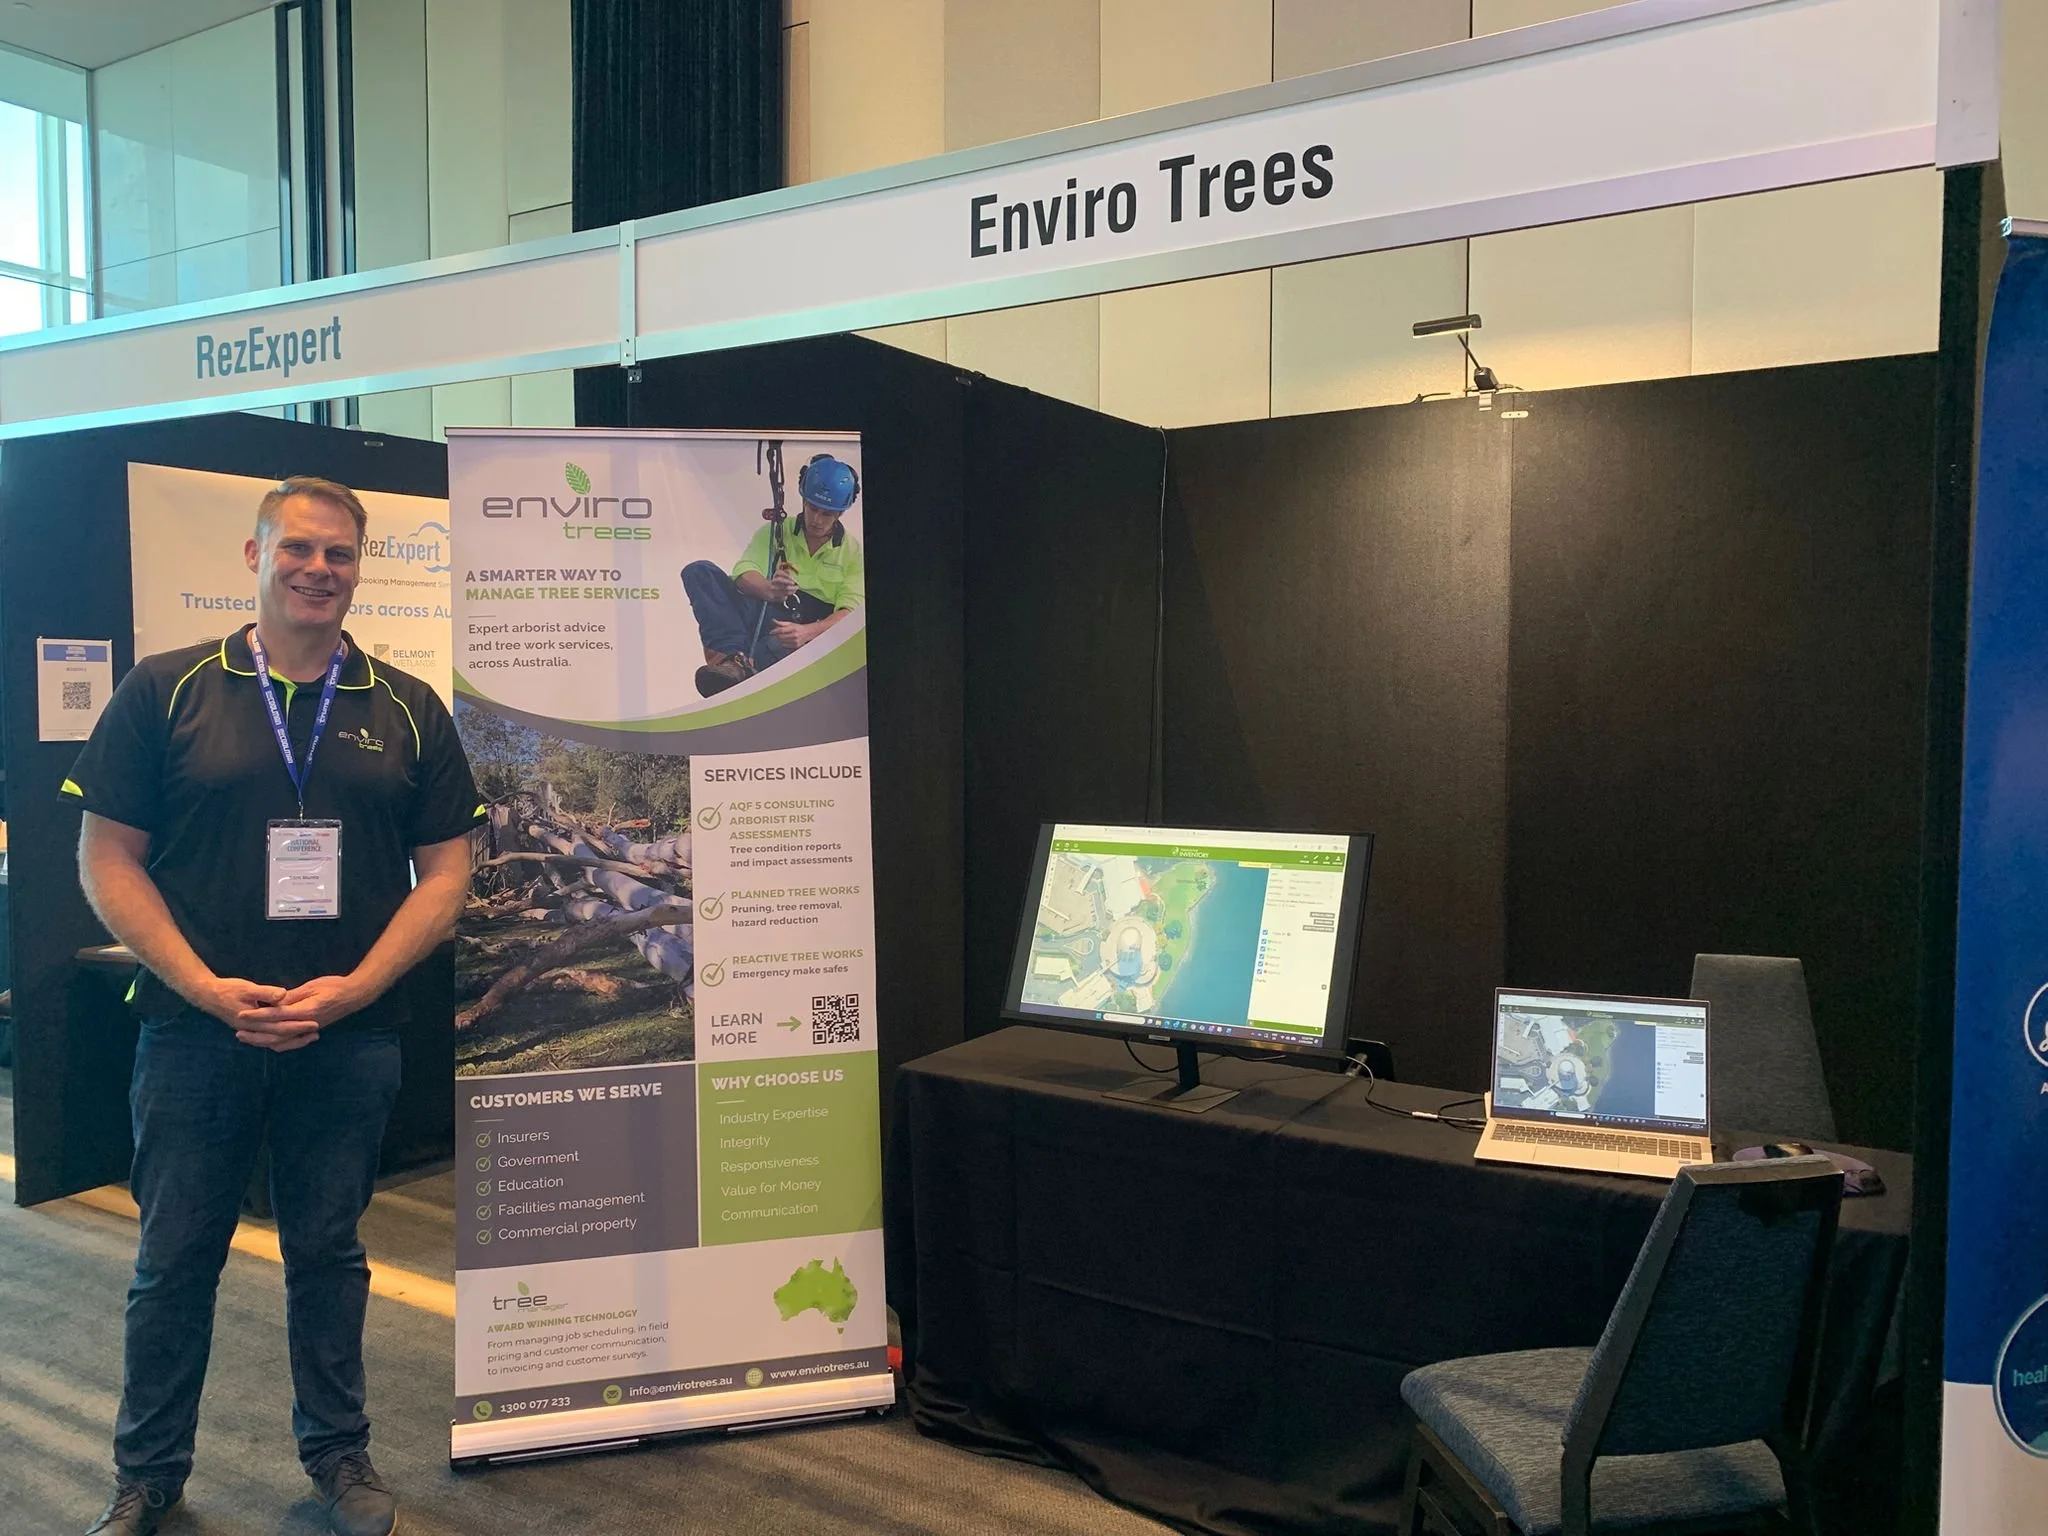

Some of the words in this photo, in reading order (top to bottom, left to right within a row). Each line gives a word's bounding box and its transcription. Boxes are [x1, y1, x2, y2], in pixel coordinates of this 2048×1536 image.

[970, 178, 1137, 258] Enviro
[1159, 144, 1334, 225] Trees
[197, 316, 342, 379] RezExpert
[482, 495, 652, 519] enviro
[563, 522, 651, 540] trees
[390, 579, 437, 588] Management
[466, 571, 476, 582] A
[479, 569, 557, 582] SMARTER
[560, 569, 598, 582] WAY
[599, 569, 622, 582] TO
[181, 593, 256, 611] Trusted
[466, 587, 535, 601] MANAGE
[538, 587, 580, 600] TREE
[583, 587, 660, 600] SERVICES
[378, 604, 429, 618] across
[433, 605, 452, 618] Au
[468, 624, 508, 637] Expert
[512, 622, 560, 633] arborist
[563, 622, 606, 633] advice
[393, 650, 435, 658] BELMONT
[468, 640, 493, 651] and
[496, 641, 521, 651] tree
[523, 640, 556, 650] work
[559, 640, 614, 652] services,
[393, 660, 436, 668] WETLANDS
[468, 659, 509, 669] across
[513, 656, 572, 668] Australia.
[318, 698, 331, 724] truma
[338, 731, 384, 747] enviro
[704, 768, 786, 782] SERVICES
[790, 765, 862, 780] INCLUDE
[729, 801, 753, 812] AQF
[755, 801, 762, 810] 5
[763, 799, 835, 810] CONSULTING
[729, 815, 787, 826] ARBORIST
[789, 814, 815, 824] RISK
[730, 829, 812, 841] ASSESSMENTS
[730, 845, 753, 854] Tree
[754, 843, 803, 853] condition
[805, 842, 842, 852] reports
[730, 859, 750, 868] and
[752, 857, 788, 868] impact
[790, 855, 853, 865] assessments
[731, 888, 785, 899] PLANNED
[787, 887, 817, 897] TREE
[818, 885, 860, 896] WORKS
[776, 903, 797, 912] tree
[731, 918, 767, 927] hazard
[769, 915, 818, 926] reduction
[732, 953, 789, 965] REACTIVE
[790, 951, 820, 962] TREE
[821, 949, 864, 960] WORKS
[732, 967, 791, 980] Emergency
[793, 965, 821, 976] make
[823, 964, 849, 974] safes
[711, 1012, 763, 1028] LEARN
[711, 1031, 757, 1046] MORE
[712, 1074, 751, 1091] WHY
[754, 1070, 820, 1087] CHOOSE
[822, 1069, 844, 1083] US
[470, 1090, 574, 1109] CUSTOMERS
[578, 1086, 606, 1102] WE
[609, 1082, 662, 1099] SERVE
[719, 1109, 769, 1126] Industry
[772, 1106, 829, 1123] Expertise
[498, 1129, 550, 1145] Insurers
[720, 1134, 770, 1150] Integrity
[497, 1150, 579, 1169] Government
[720, 1155, 819, 1174] Responsiveness
[498, 1175, 564, 1193] Education
[721, 1181, 757, 1197] Value
[759, 1180, 777, 1193] for
[780, 1178, 822, 1194] Money
[498, 1199, 555, 1217] Facilities
[558, 1191, 645, 1213] management
[721, 1202, 819, 1222] Communication
[498, 1220, 578, 1241] Commercial
[581, 1215, 638, 1235] property
[493, 1295, 548, 1311] tree
[487, 1321, 525, 1333] AWARD
[527, 1316, 572, 1328] WINNING
[574, 1309, 638, 1324] TECHNOLOGY
[487, 1340, 513, 1349] From
[515, 1334, 564, 1346] managing
[564, 1331, 581, 1343] job
[638, 1324, 647, 1332] in
[649, 1321, 669, 1331] field
[487, 1352, 522, 1364] pricing
[523, 1349, 542, 1358] and
[543, 1344, 588, 1356] customer
[487, 1367, 498, 1375] to
[500, 1361, 544, 1374] invoicing
[545, 1359, 564, 1368] and
[565, 1353, 610, 1366] customer
[770, 1359, 870, 1380] www.envirotrees.au
[2013, 1364, 2048, 1387] heal
[629, 1375, 733, 1397] info@envirotrees.au
[500, 1400, 527, 1413] 1300
[529, 1398, 549, 1410] 077
[551, 1395, 571, 1408] 233
